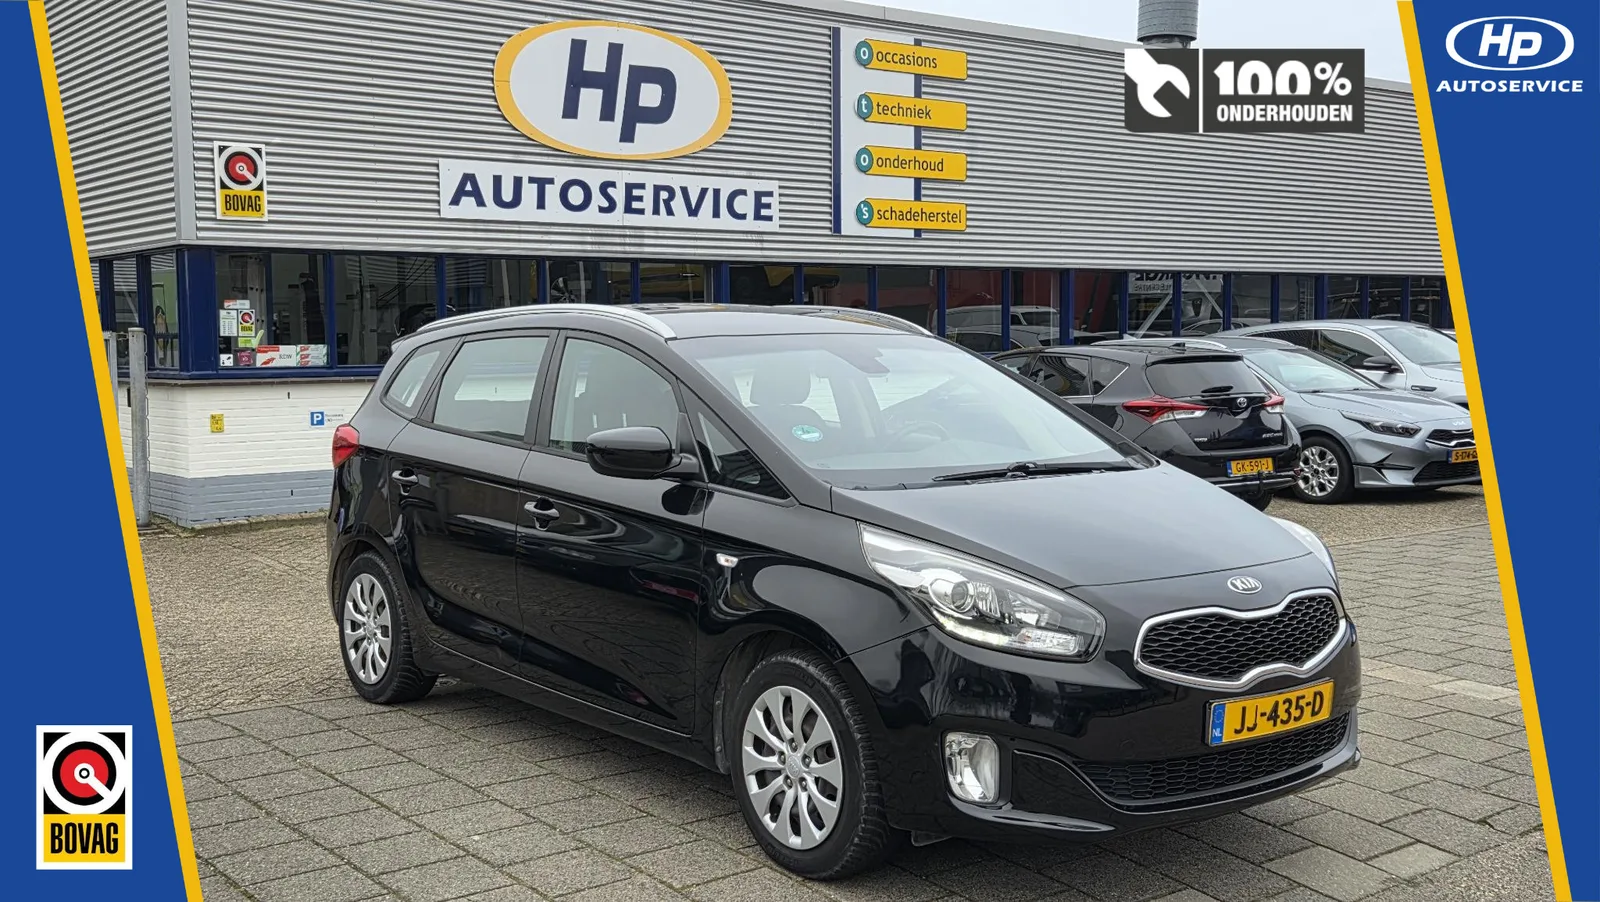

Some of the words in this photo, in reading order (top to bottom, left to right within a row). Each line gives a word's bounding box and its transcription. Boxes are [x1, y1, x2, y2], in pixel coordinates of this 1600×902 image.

[876, 50, 938, 69] occasions
[876, 101, 932, 120] techniek
[876, 154, 944, 172] onderhoud
[224, 193, 262, 213] BOVAG
[448, 172, 775, 222] AUTOSERVICE
[876, 206, 962, 224] schadeherstel
[1235, 460, 1269, 473] GK-591-J
[1232, 577, 1260, 591] KIA
[1233, 690, 1325, 734] JJ-435-D
[1212, 728, 1223, 738] NL
